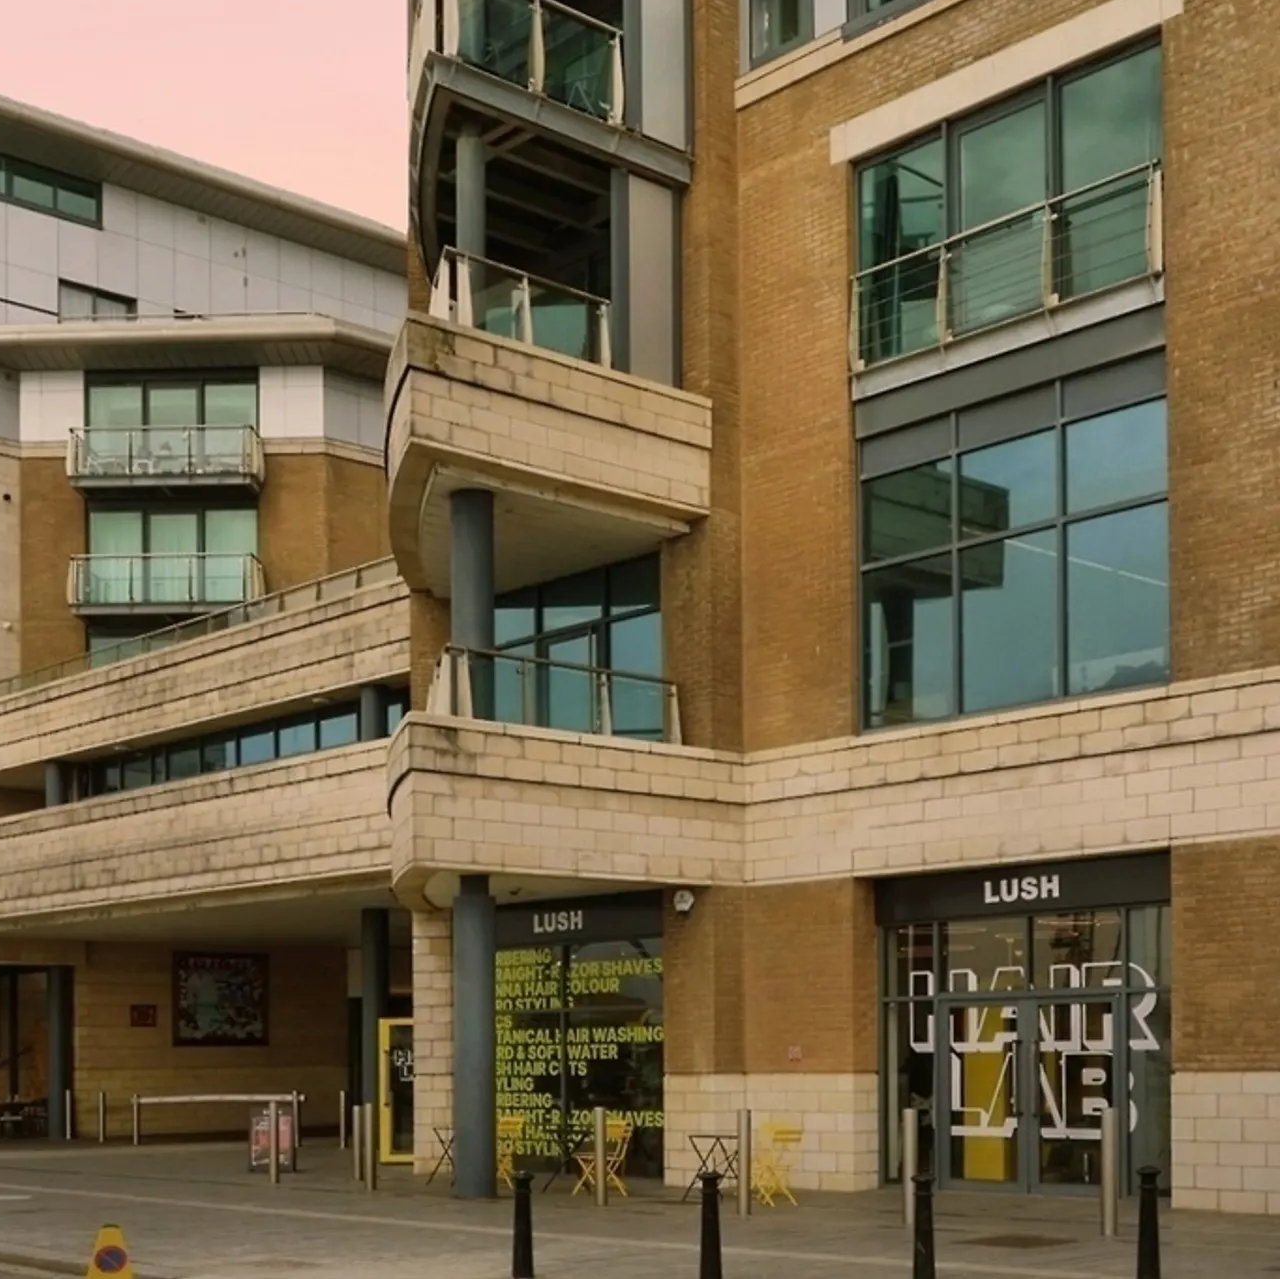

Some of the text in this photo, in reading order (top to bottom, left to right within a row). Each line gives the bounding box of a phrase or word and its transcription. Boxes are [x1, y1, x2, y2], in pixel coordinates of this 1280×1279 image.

[984, 875, 1060, 903] LUSH
[533, 910, 583, 934] LUSH
[601, 958, 663, 977] SHAVES
[524, 980, 558, 996] HAIR
[910, 961, 1160, 1052] HAIR
[496, 1028, 553, 1044] TANICAL
[592, 1026, 664, 1043] WASHING
[496, 1043, 619, 1060] RD & SOFT WATER
[513, 1061, 547, 1076] HAIR
[548, 1060, 588, 1077] CTS
[496, 1076, 535, 1091] YLING
